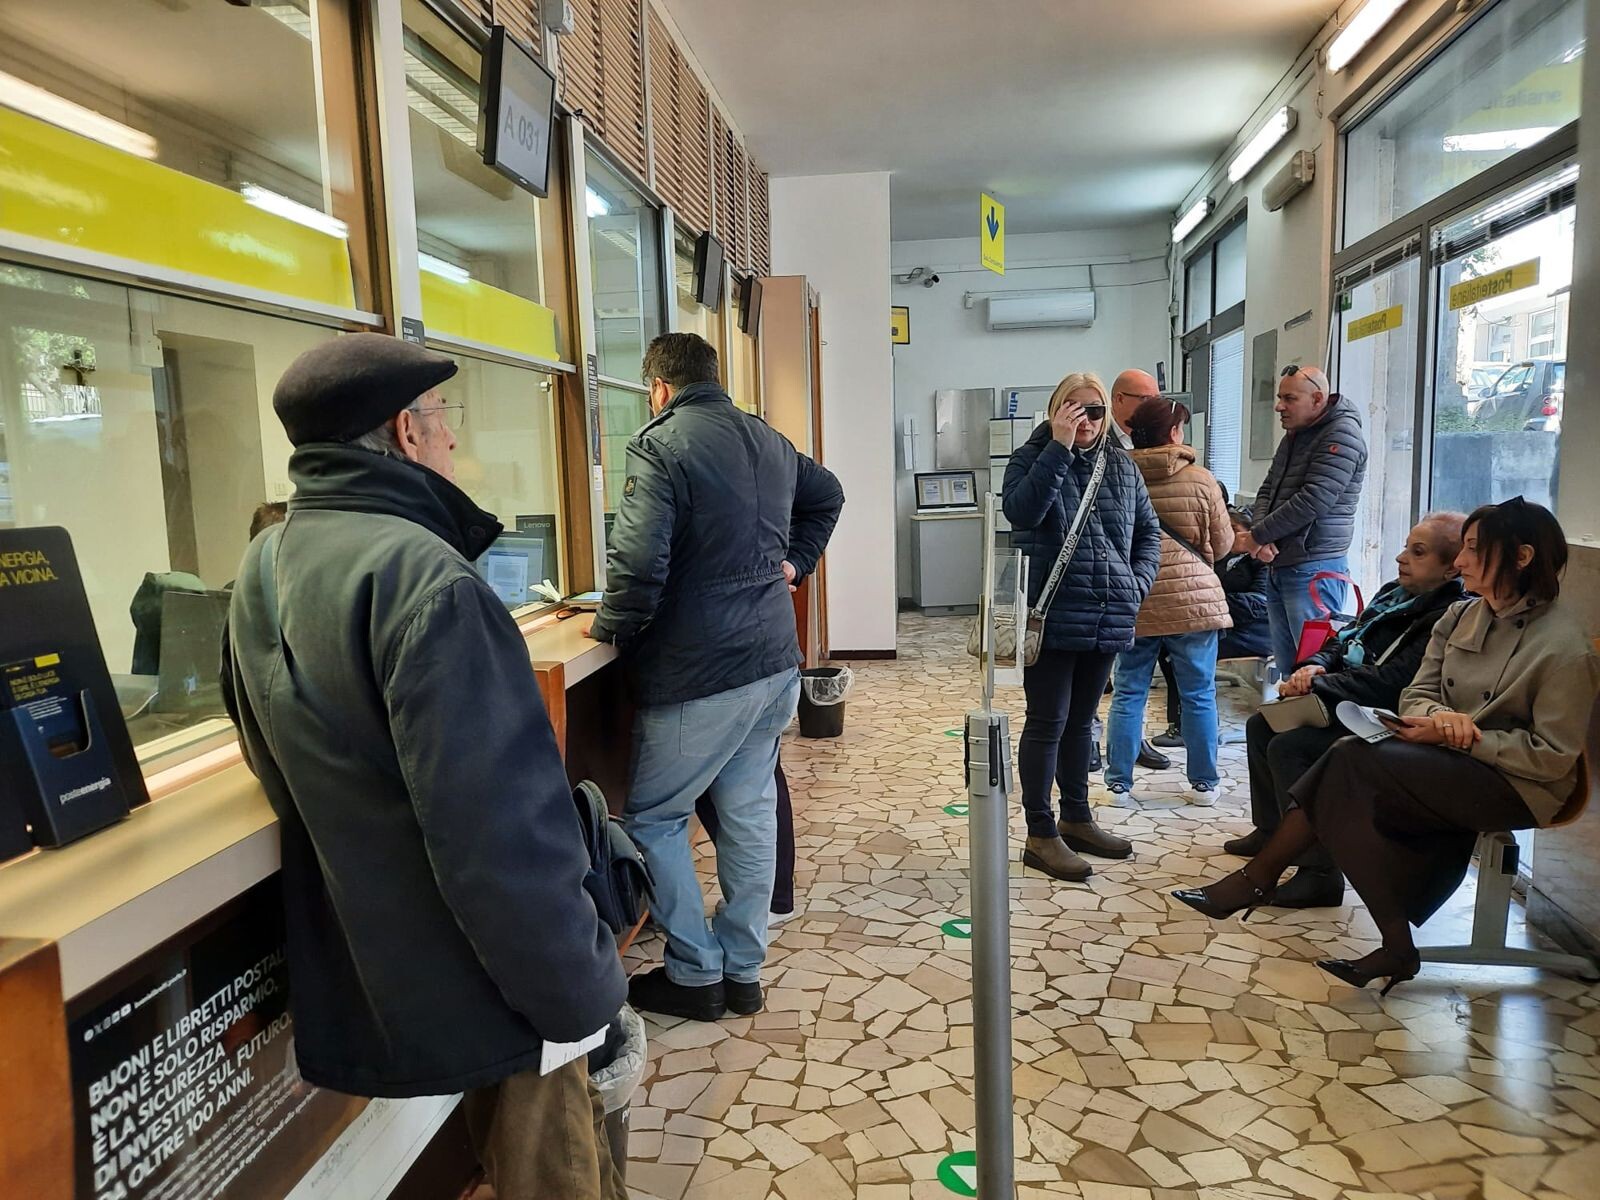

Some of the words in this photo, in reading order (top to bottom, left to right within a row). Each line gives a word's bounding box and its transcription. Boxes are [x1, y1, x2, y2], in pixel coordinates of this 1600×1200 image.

[503, 104, 514, 140] A
[518, 115, 540, 156] 031
[523, 520, 551, 529] Lenovo
[89, 1045, 150, 1108] BUONI
[152, 1034, 165, 1059] E
[166, 983, 232, 1049] LIBRETTI
[91, 1083, 138, 1137] NON
[139, 1068, 152, 1097] È
[154, 1037, 199, 1085] SOLO
[92, 1132, 108, 1165] È
[109, 1114, 137, 1151] LA
[138, 1041, 226, 1126] SICUREZZA
[94, 1155, 117, 1193] DI
[119, 1080, 206, 1171] INVESTIRE
[207, 1059, 236, 1093] SUL
[236, 1011, 293, 1068] FUTURO.
[128, 1124, 185, 1189] OLTRE
[186, 1101, 214, 1137] 100
[216, 1066, 255, 1113] ANNI.
